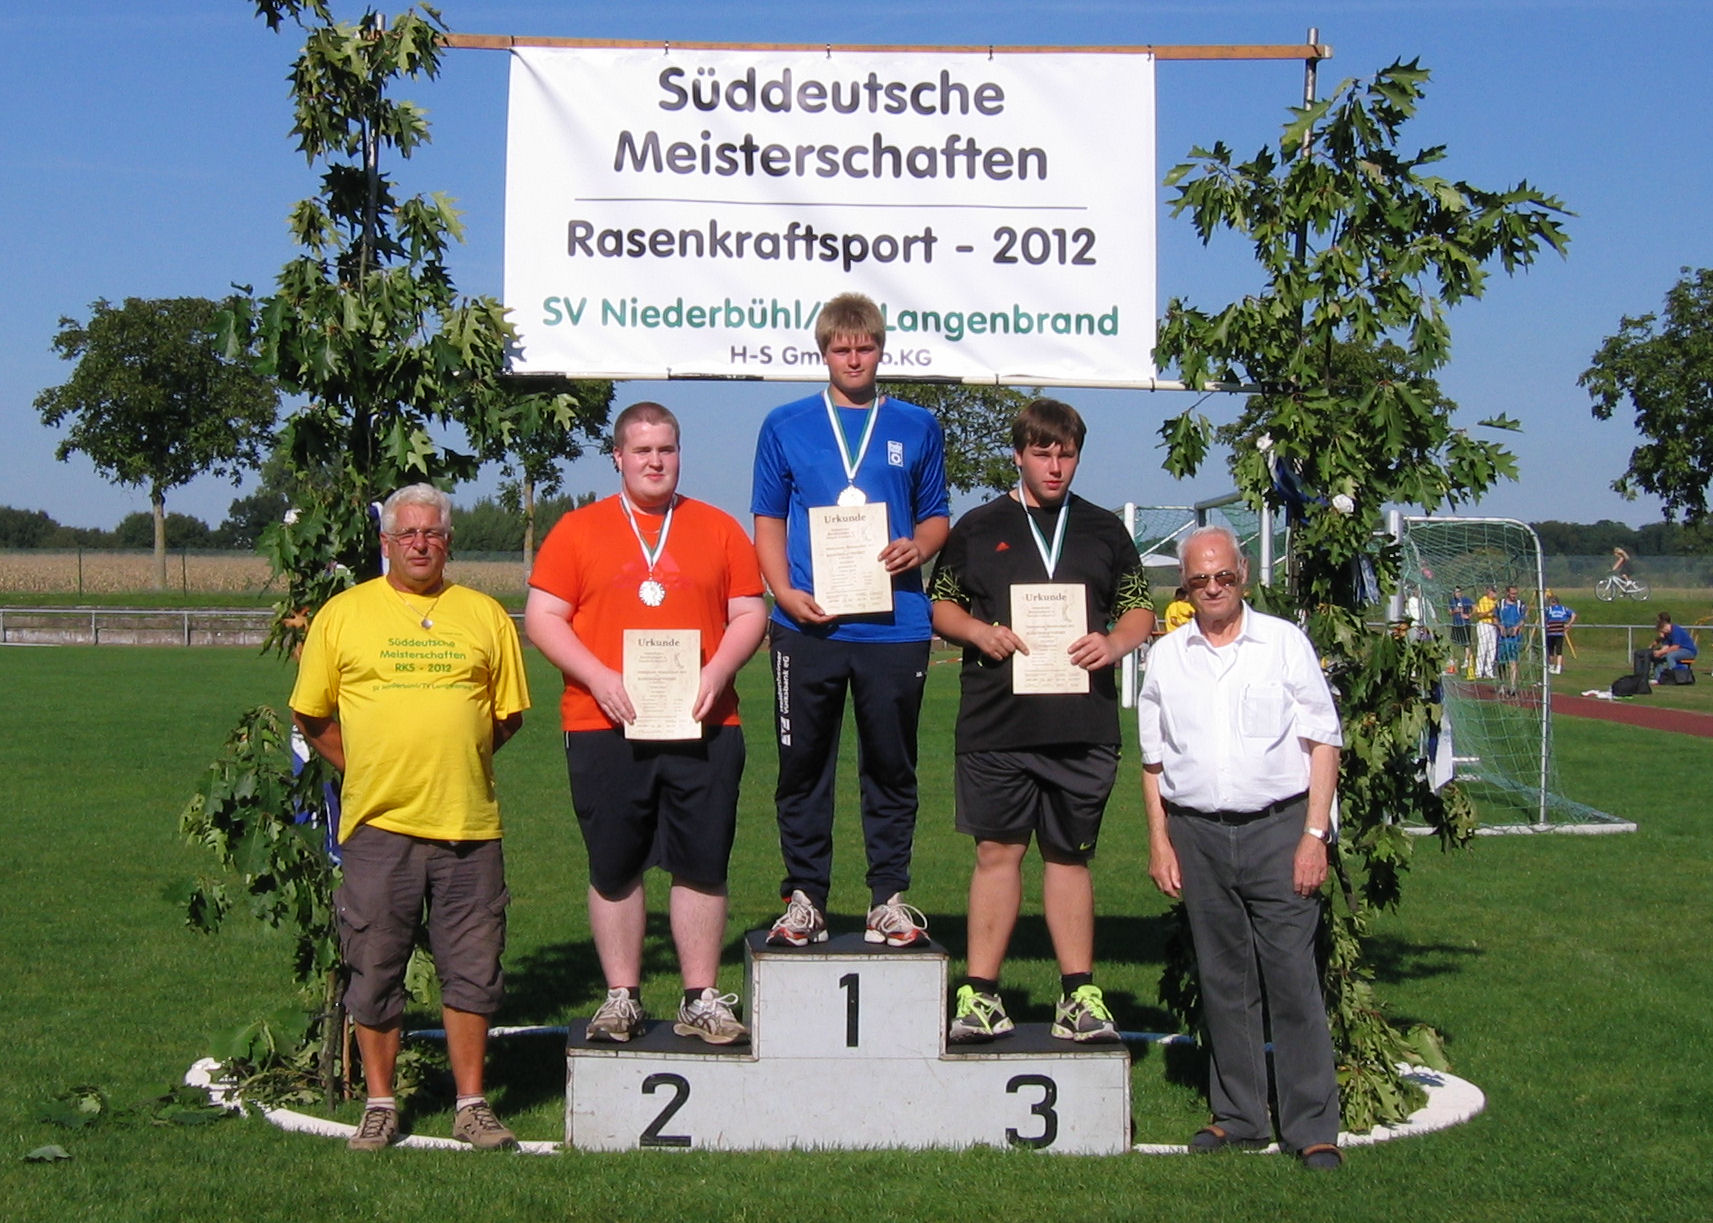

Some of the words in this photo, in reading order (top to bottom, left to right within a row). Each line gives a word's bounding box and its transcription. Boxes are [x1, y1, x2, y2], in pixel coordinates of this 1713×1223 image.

[658, 66, 1005, 116] Süddeutsche
[613, 130, 1048, 181] Meisterschaften
[567, 219, 938, 272] Rasenkraftsport
[956, 245, 974, 253] -
[992, 226, 1097, 266] 2012
[543, 297, 586, 327] SV
[881, 303, 1119, 343] Langenbrand
[731, 345, 773, 364] H-S
[824, 513, 867, 524] Urkunde
[1025, 592, 1067, 602] Urkunde
[379, 649, 467, 660] Meisterschaften
[387, 637, 456, 648] Süddeutsche
[638, 637, 681, 647] Urkunde
[394, 663, 416, 673] RKS
[427, 663, 453, 673] 2012
[839, 972, 860, 1048] 1
[639, 1073, 692, 1148] 2
[1005, 1074, 1058, 1149] 3
